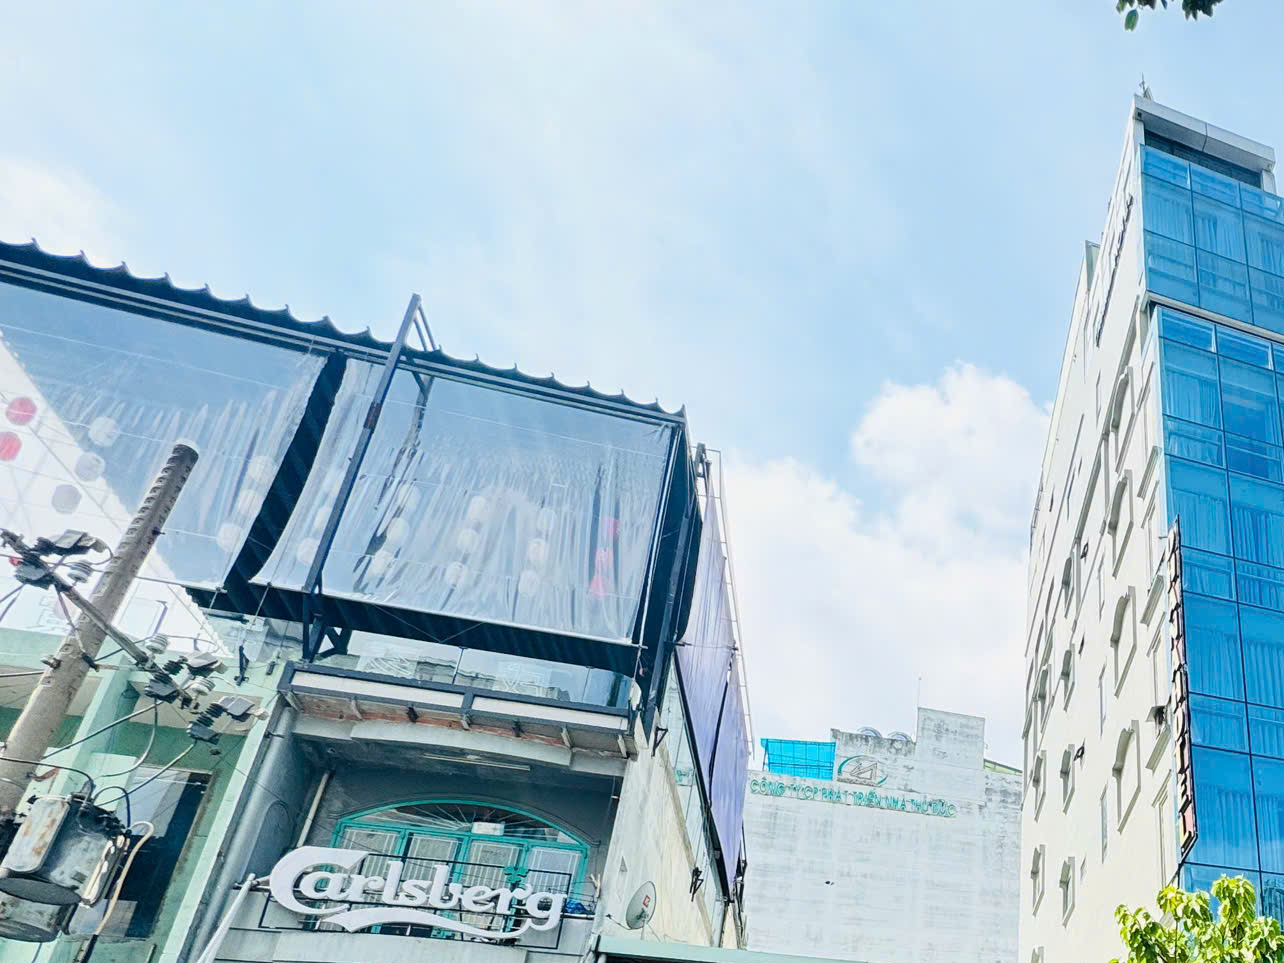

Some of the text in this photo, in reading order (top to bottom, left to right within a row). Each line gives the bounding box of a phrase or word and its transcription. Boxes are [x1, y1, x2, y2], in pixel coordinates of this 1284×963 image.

[750, 777, 785, 796] CÔNG
[804, 786, 819, 800] CP
[269, 845, 568, 931] Carlsberg
